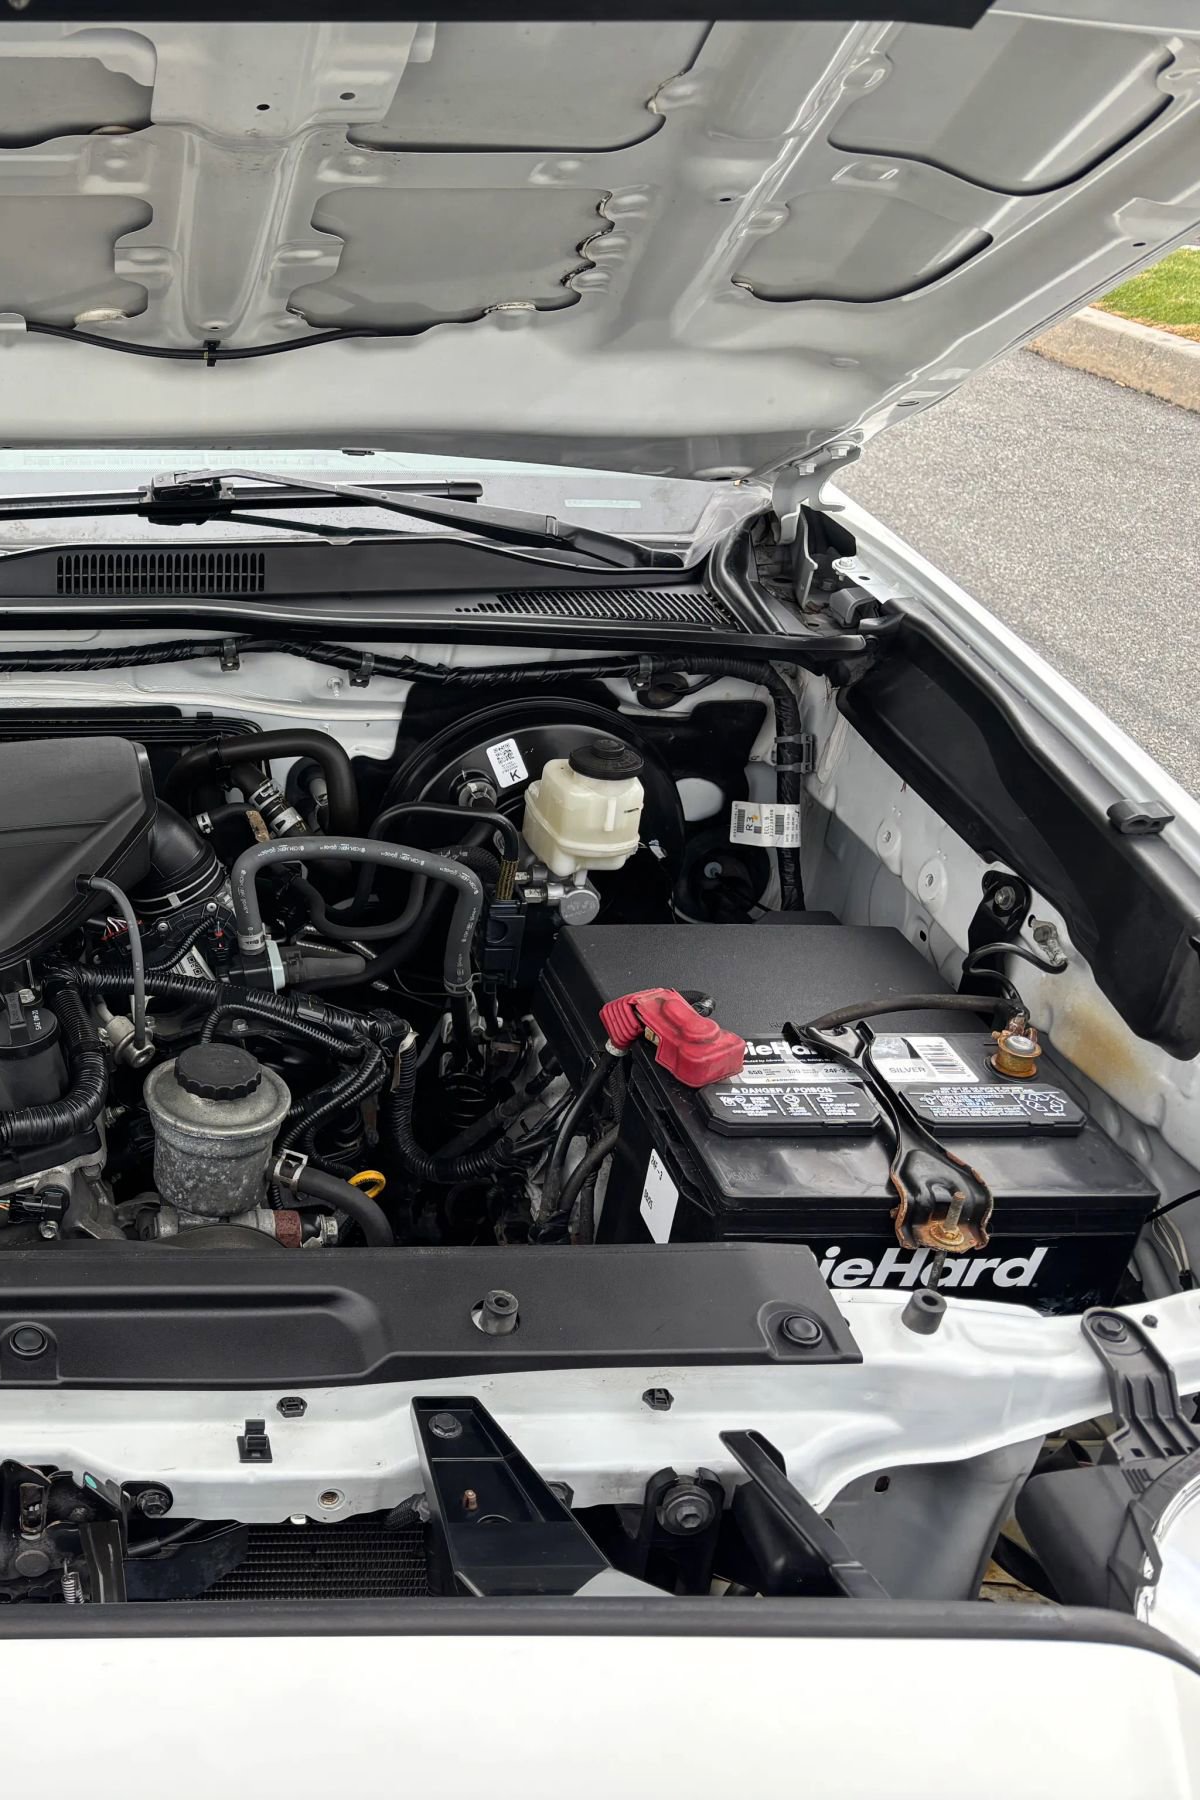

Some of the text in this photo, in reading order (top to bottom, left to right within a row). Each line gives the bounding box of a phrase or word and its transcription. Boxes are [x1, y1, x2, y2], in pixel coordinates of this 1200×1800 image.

[510, 769, 521, 781] K
[744, 1041, 819, 1056] ieHa
[888, 1066, 927, 1074] SILVER
[819, 1246, 1049, 1288] ieHard
